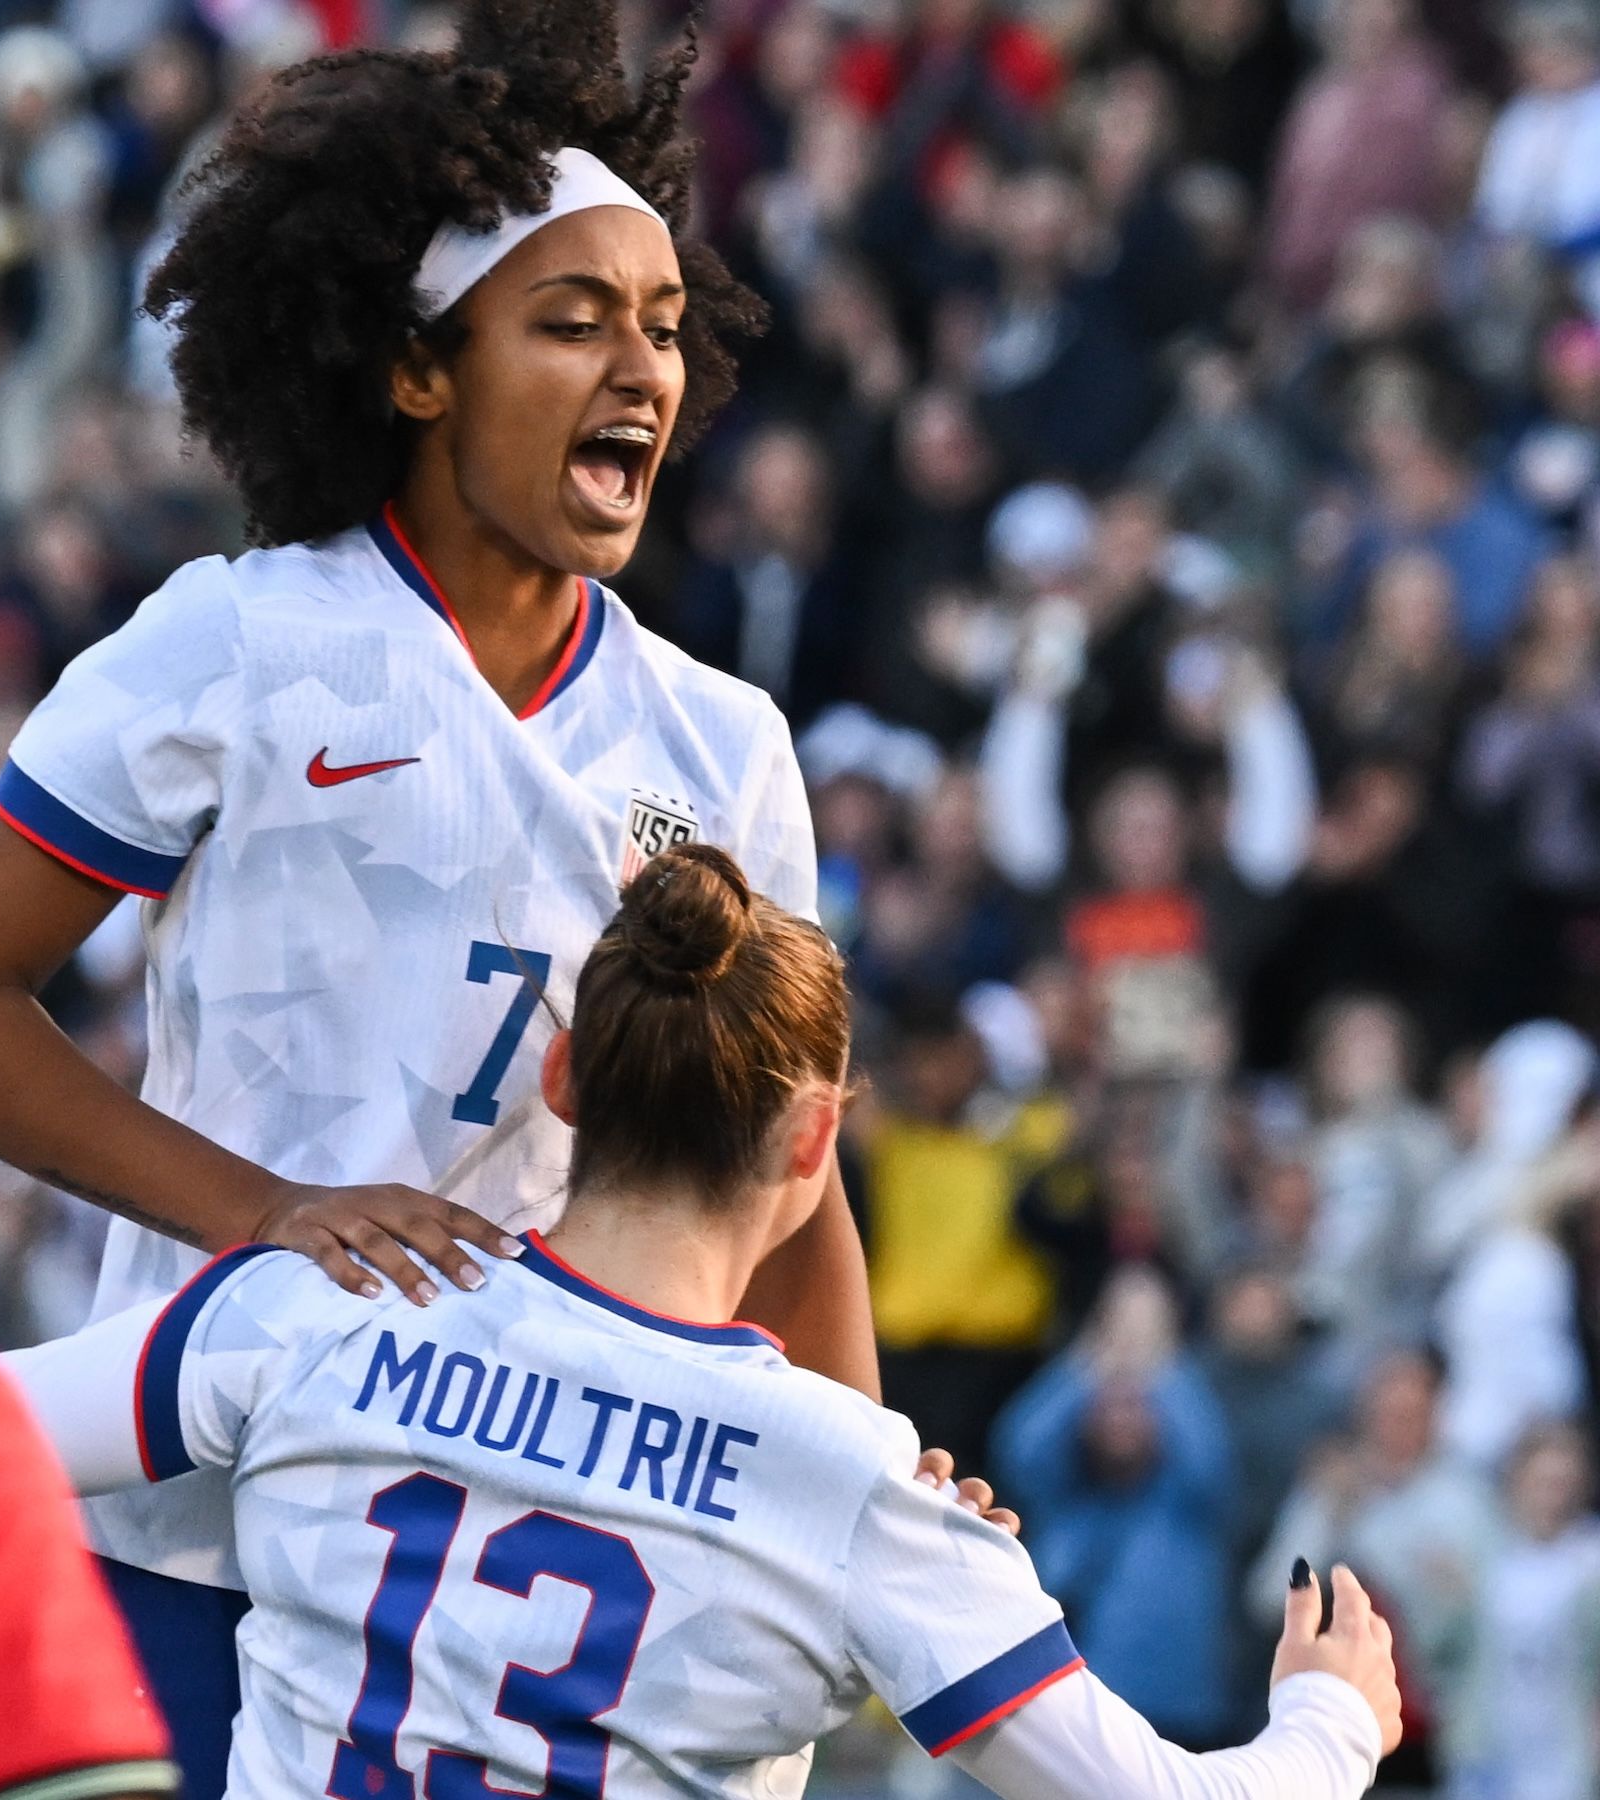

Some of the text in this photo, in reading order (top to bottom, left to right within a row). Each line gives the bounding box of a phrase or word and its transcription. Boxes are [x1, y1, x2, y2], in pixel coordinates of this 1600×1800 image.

[632, 809, 690, 857] USA
[451, 940, 552, 1126] 7
[352, 1330, 759, 1522] MOULTRIE
[326, 1470, 656, 1800] 13
